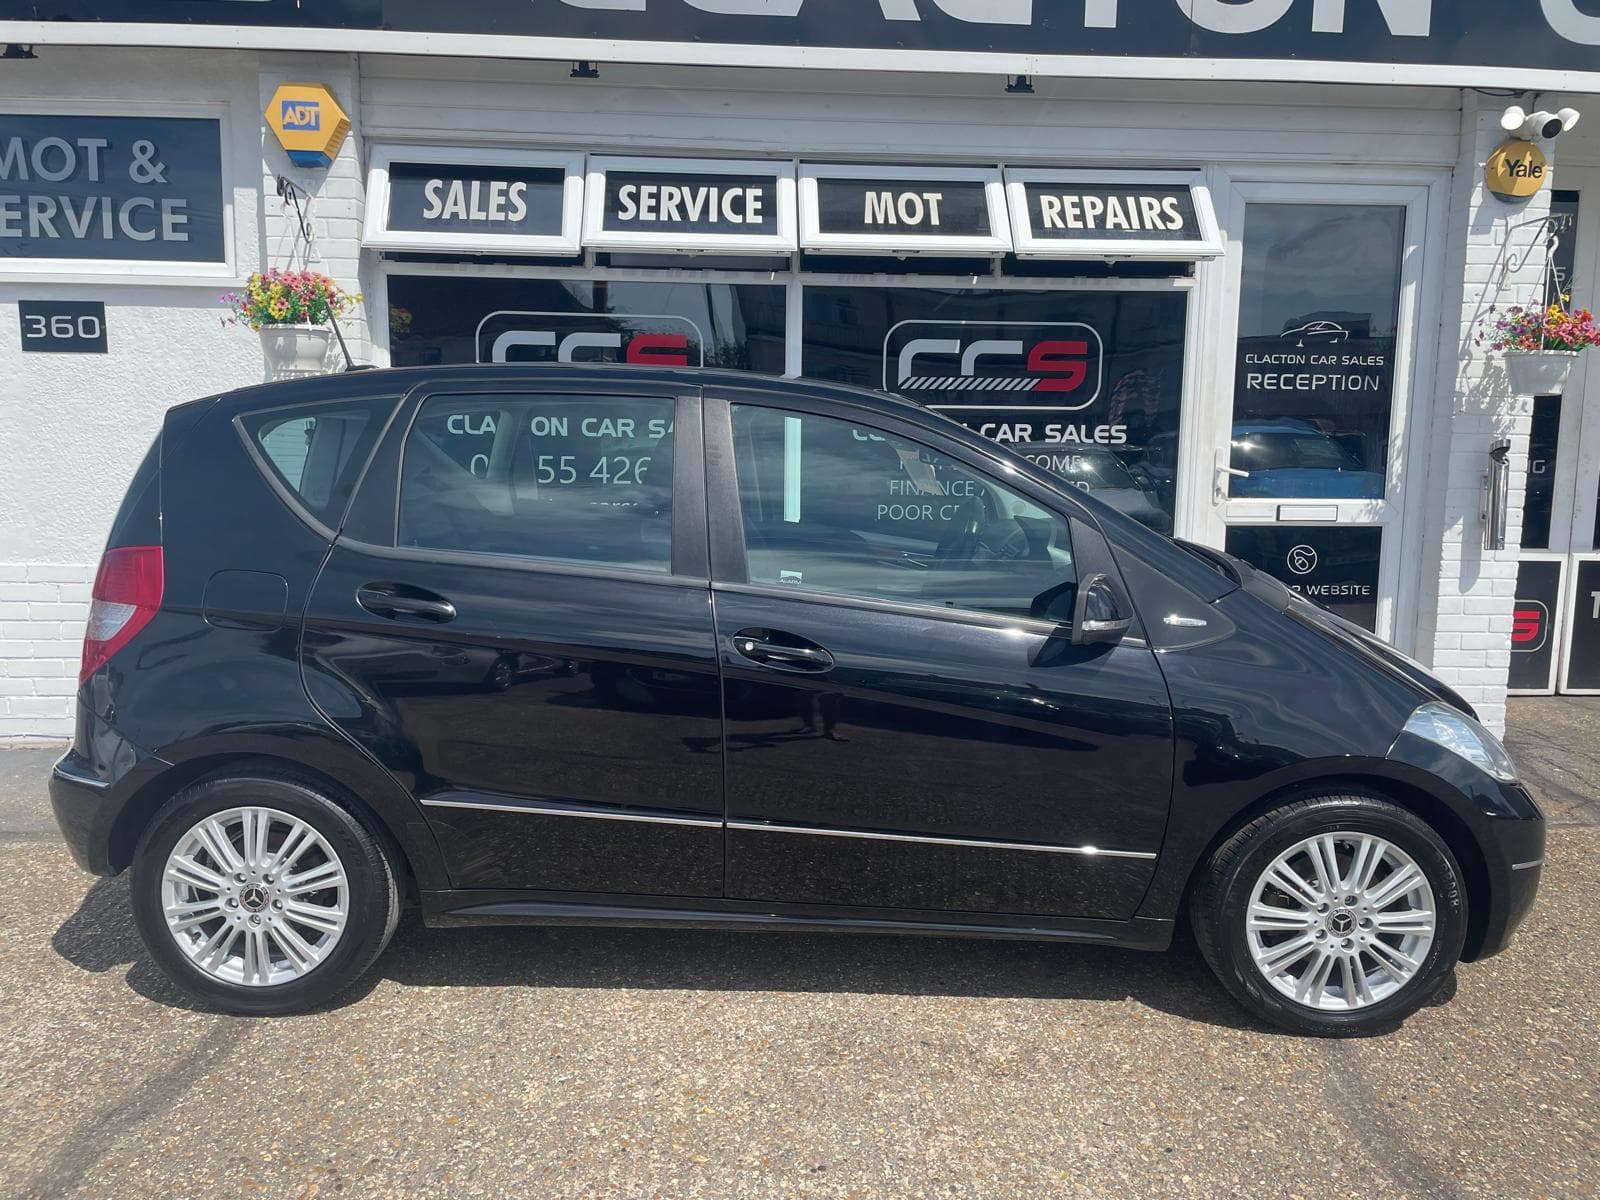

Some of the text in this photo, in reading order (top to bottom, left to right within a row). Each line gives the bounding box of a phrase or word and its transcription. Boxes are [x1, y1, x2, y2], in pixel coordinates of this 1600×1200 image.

[283, 105, 320, 127] ADT
[128, 140, 167, 184] &
[1504, 158, 1543, 179] Yale
[423, 179, 527, 222] SALES
[617, 184, 763, 224] SERVICE
[864, 191, 943, 226] MOT
[1040, 195, 1184, 230] REPAIRS
[0, 195, 189, 241] ERVICE
[25, 315, 100, 339] 360
[1245, 354, 1385, 366] CLACTON CAR SALES
[1246, 373, 1379, 391] RECEPTION
[447, 414, 568, 437] CLAON
[581, 417, 636, 438] CAR
[981, 422, 1128, 444] CAR SALES
[470, 453, 577, 485] 055
[889, 480, 975, 497] FINNCE
[877, 504, 933, 521] POOR
[1306, 584, 1371, 596] WEBSITE
